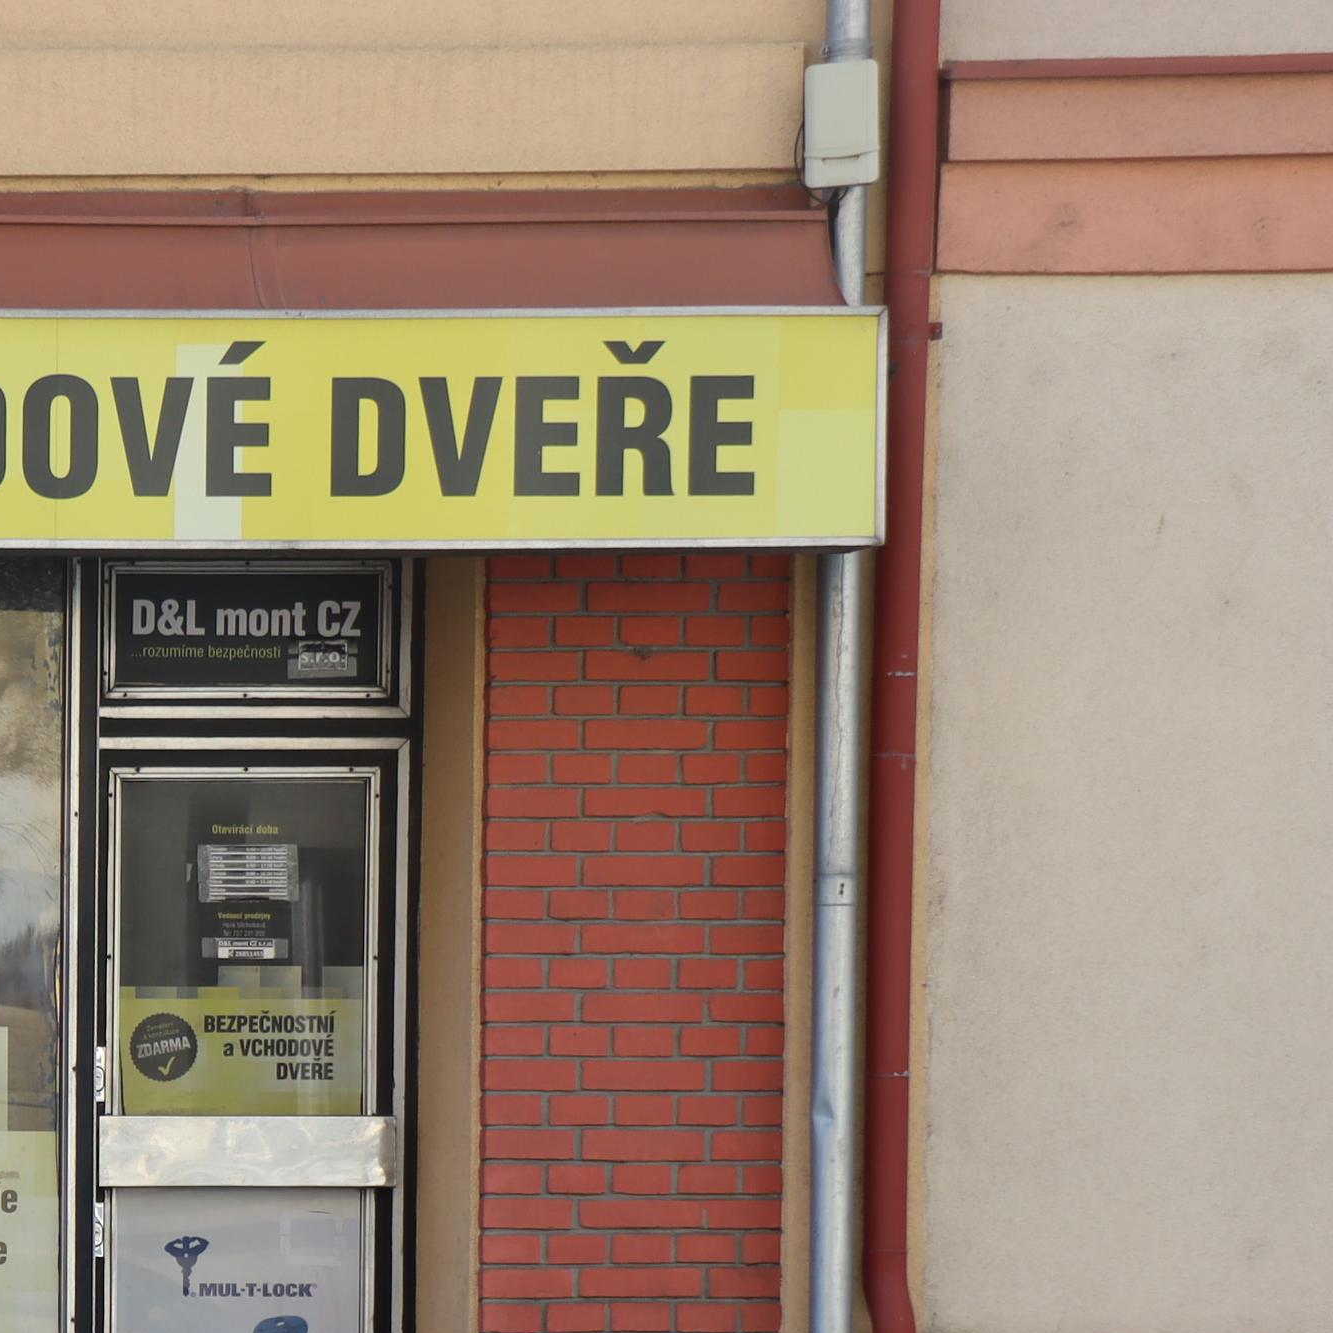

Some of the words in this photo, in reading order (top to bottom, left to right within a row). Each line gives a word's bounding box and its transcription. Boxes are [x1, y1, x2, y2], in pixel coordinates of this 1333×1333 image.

[330, 340, 755, 497] DVEŘE
[132, 599, 205, 637] D&L
[216, 602, 306, 637] mont
[317, 600, 361, 638] CZ
[208, 645, 281, 661] bezpečnosti
[204, 1010, 337, 1033] BEZPEČNOSTNÍ
[136, 1035, 191, 1059] ZDARMA
[223, 1041, 235, 1057] a
[240, 1035, 335, 1057] VCHODOVÉ
[276, 1058, 334, 1081] DVEŘE
